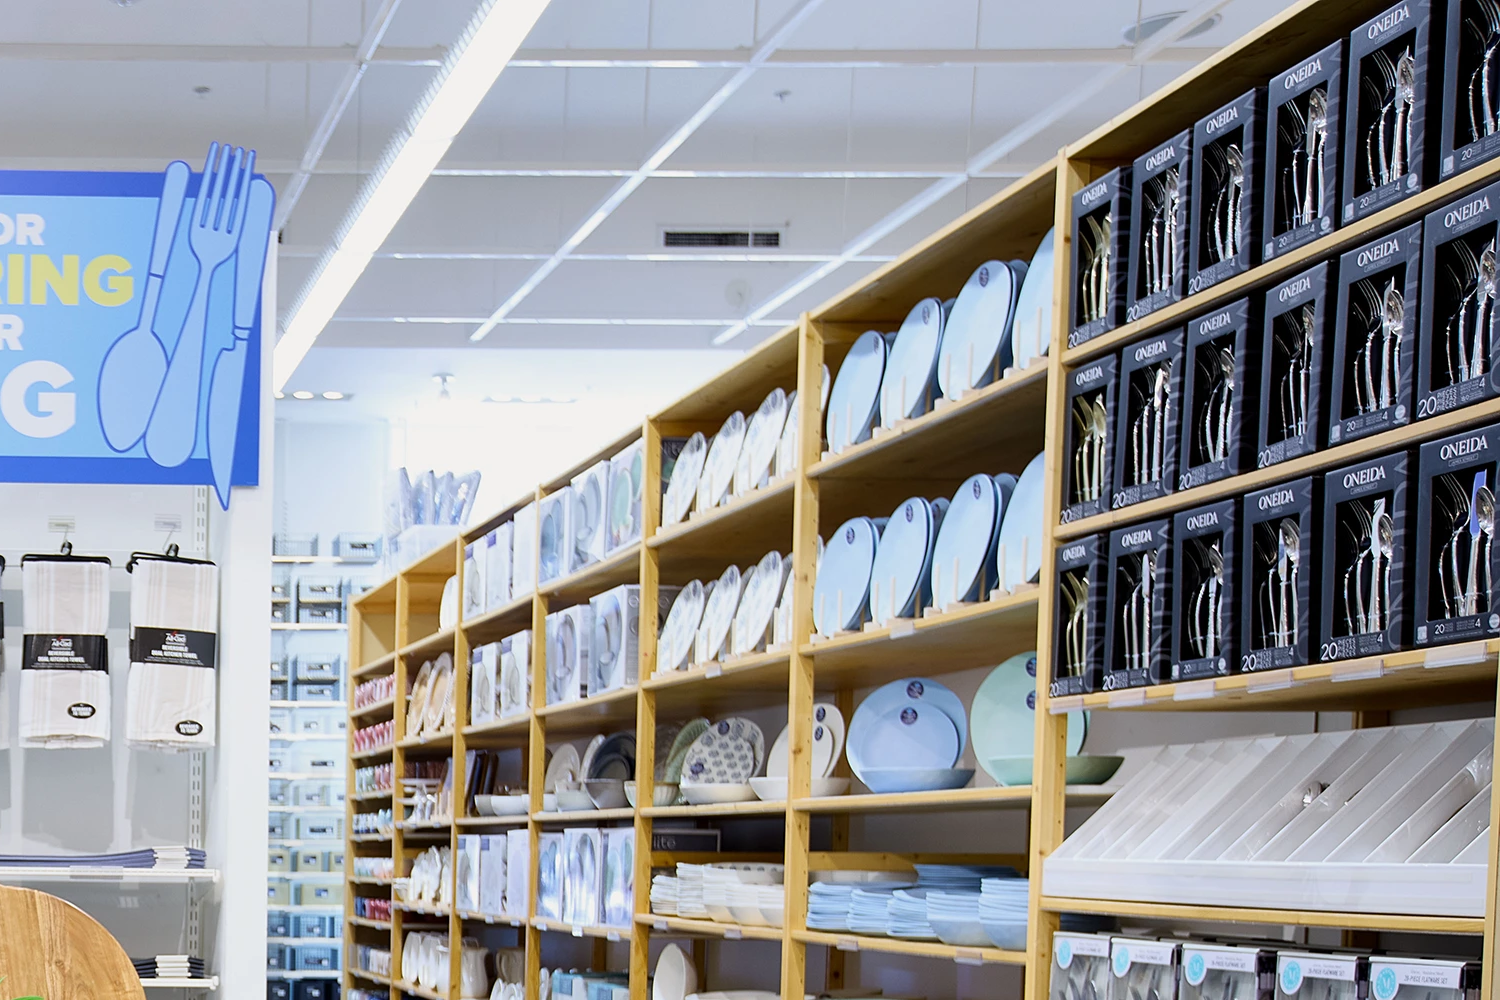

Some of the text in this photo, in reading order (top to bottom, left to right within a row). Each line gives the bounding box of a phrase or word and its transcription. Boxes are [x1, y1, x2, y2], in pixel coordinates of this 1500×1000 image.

[1368, 5, 1410, 40] ONEIDA
[1284, 58, 1322, 90] ONEIDA
[1206, 107, 1238, 134] ONEIDA
[1146, 145, 1175, 171] ONEIDA
[1461, 148, 1473, 161] 20
[1082, 182, 1107, 206] ONEIDA
[1360, 196, 1369, 209] 20
[1444, 196, 1491, 228] ONEIDA
[1357, 239, 1400, 267] ONEIDA
[1188, 275, 1202, 295] 20
[1279, 276, 1311, 302] ONEIDA
[1127, 305, 1140, 323] 20
[1200, 312, 1231, 335] ONEIDA
[1135, 340, 1167, 362] ONEIDA
[1076, 366, 1103, 386] ONEIDA
[1418, 396, 1437, 417] 20
[1346, 420, 1356, 432] 20
[1440, 434, 1488, 460] ONEIDA
[1258, 450, 1271, 469] 20
[1179, 473, 1192, 491] 20
[1343, 465, 1386, 489] ONEIDA
[1112, 492, 1126, 508] 20
[1258, 489, 1294, 511] ONEIDA
[1187, 512, 1218, 532] ONEIDA
[1121, 529, 1152, 548] ONEIDA
[1062, 545, 1086, 562] ONEIDA
[1434, 624, 1445, 634] 20
[1321, 642, 1338, 660] 20
[1242, 654, 1257, 671] 20
[1103, 675, 1115, 691] 20
